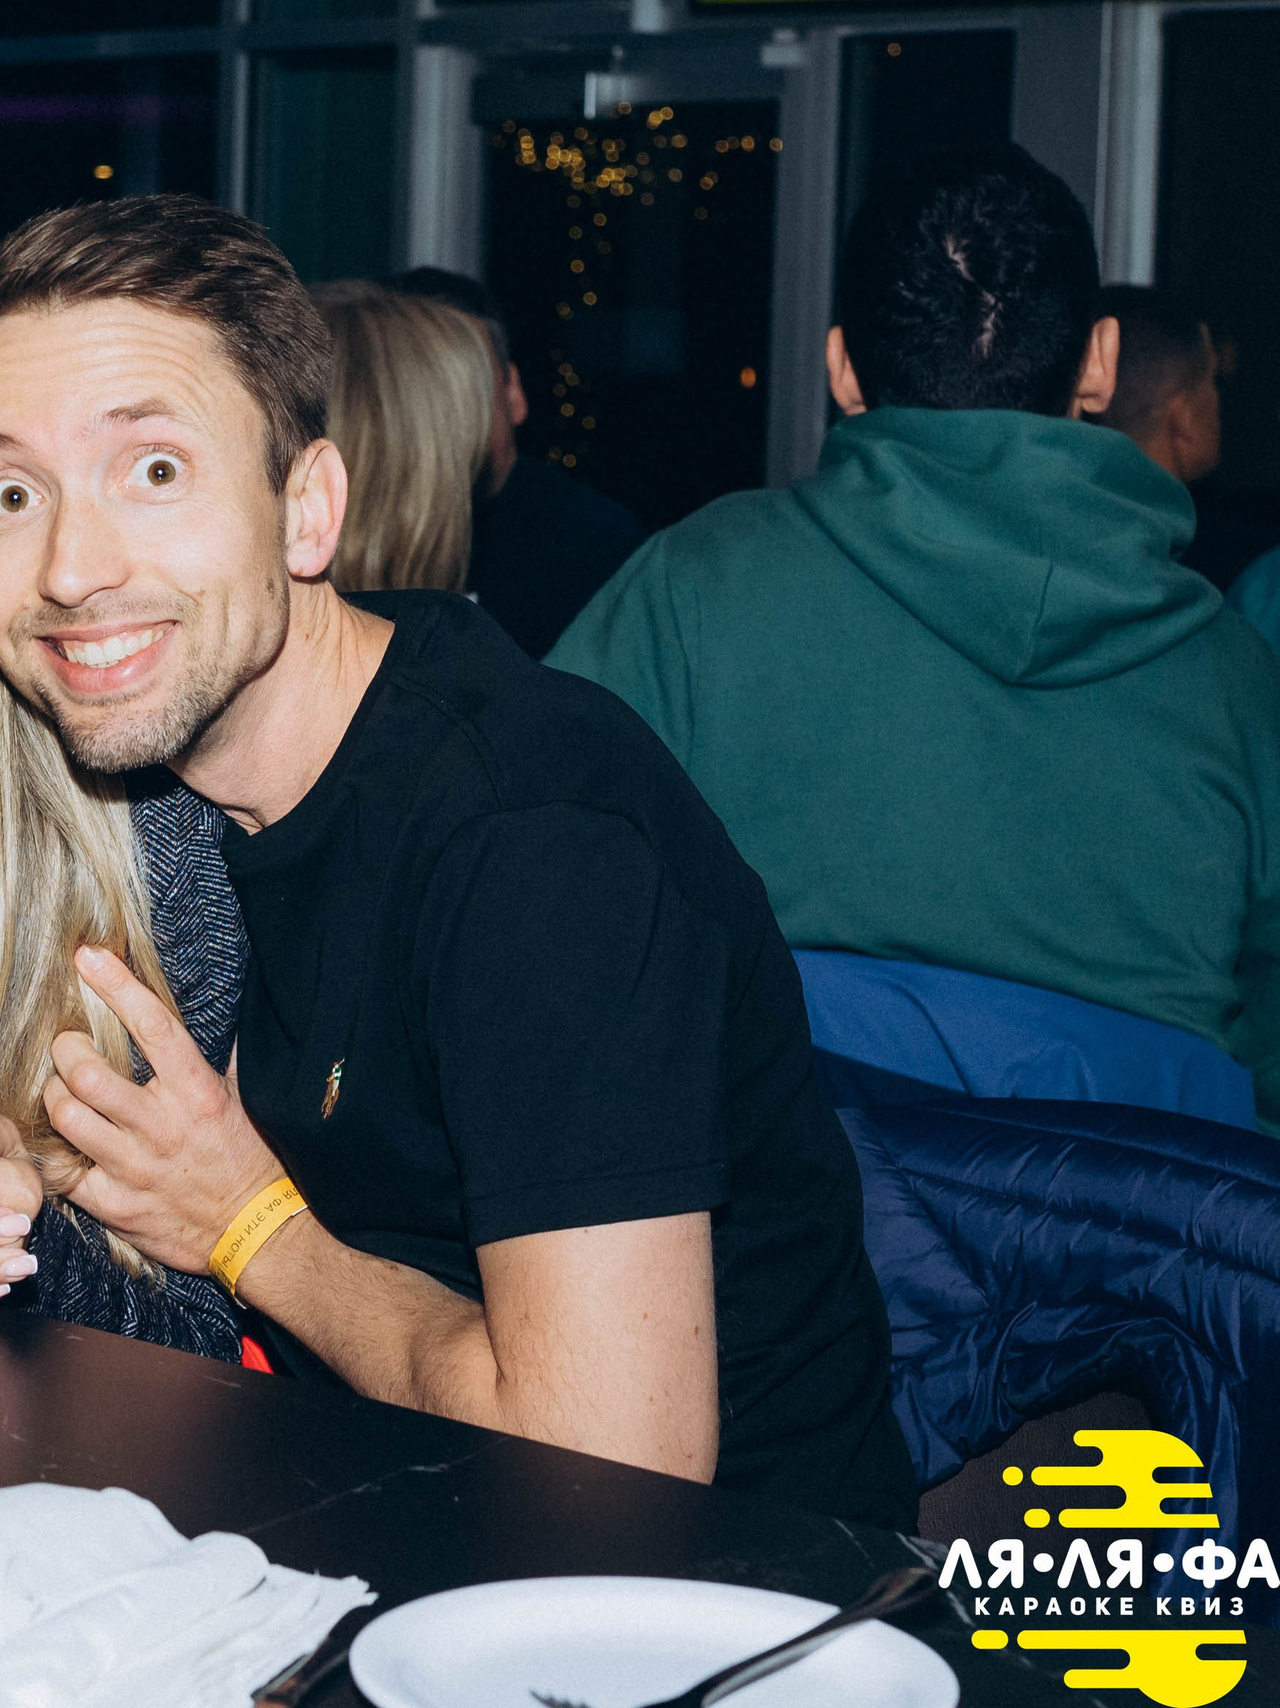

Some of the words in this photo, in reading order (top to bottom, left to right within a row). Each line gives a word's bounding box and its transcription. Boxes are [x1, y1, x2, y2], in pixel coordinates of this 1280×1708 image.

[265, 1198, 282, 1212] ФА
[244, 1212, 266, 1235] ЭТИ
[221, 1235, 246, 1268] НОТЫ
